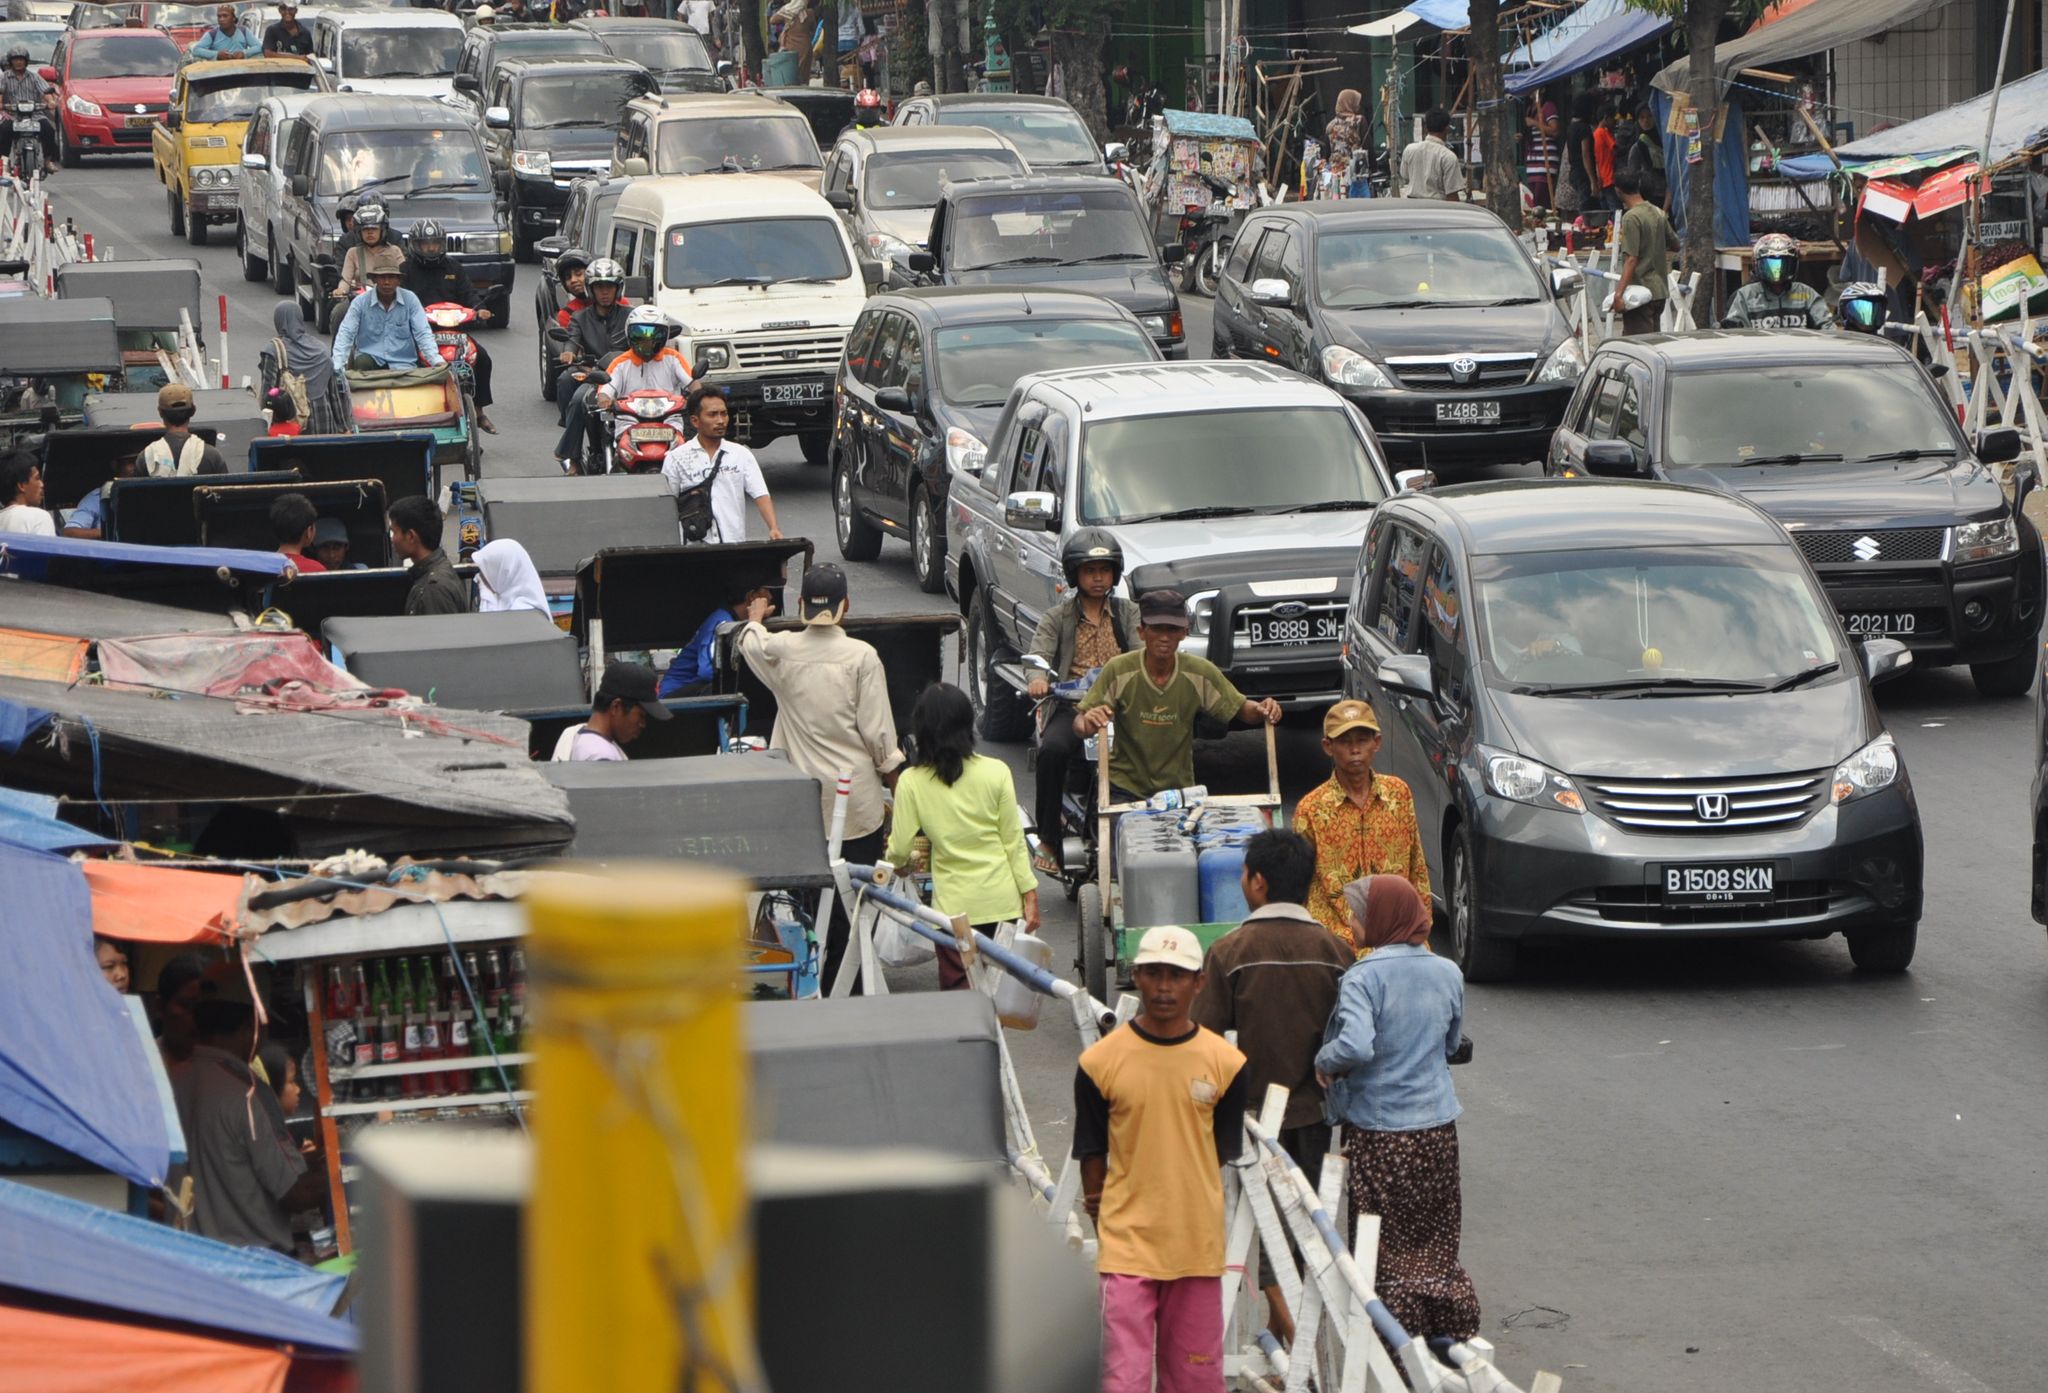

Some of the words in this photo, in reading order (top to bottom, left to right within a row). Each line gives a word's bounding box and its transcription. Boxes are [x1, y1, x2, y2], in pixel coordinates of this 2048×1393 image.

[1980, 223, 2001, 237] ERVIS
[763, 386, 772, 400] B
[776, 385, 803, 400] 2812
[808, 384, 824, 398] YP
[1437, 404, 1445, 418] E
[1448, 403, 1478, 418] 1486
[1483, 402, 1500, 417] KJ
[1251, 622, 1263, 642] B
[1269, 619, 1309, 640] 9889
[1316, 618, 1337, 637] SW
[1849, 614, 1889, 632] 2021
[1895, 613, 1915, 632] YD
[1667, 869, 1680, 891] B
[1683, 869, 1730, 891] 1508
[1732, 867, 1773, 890] SKN
